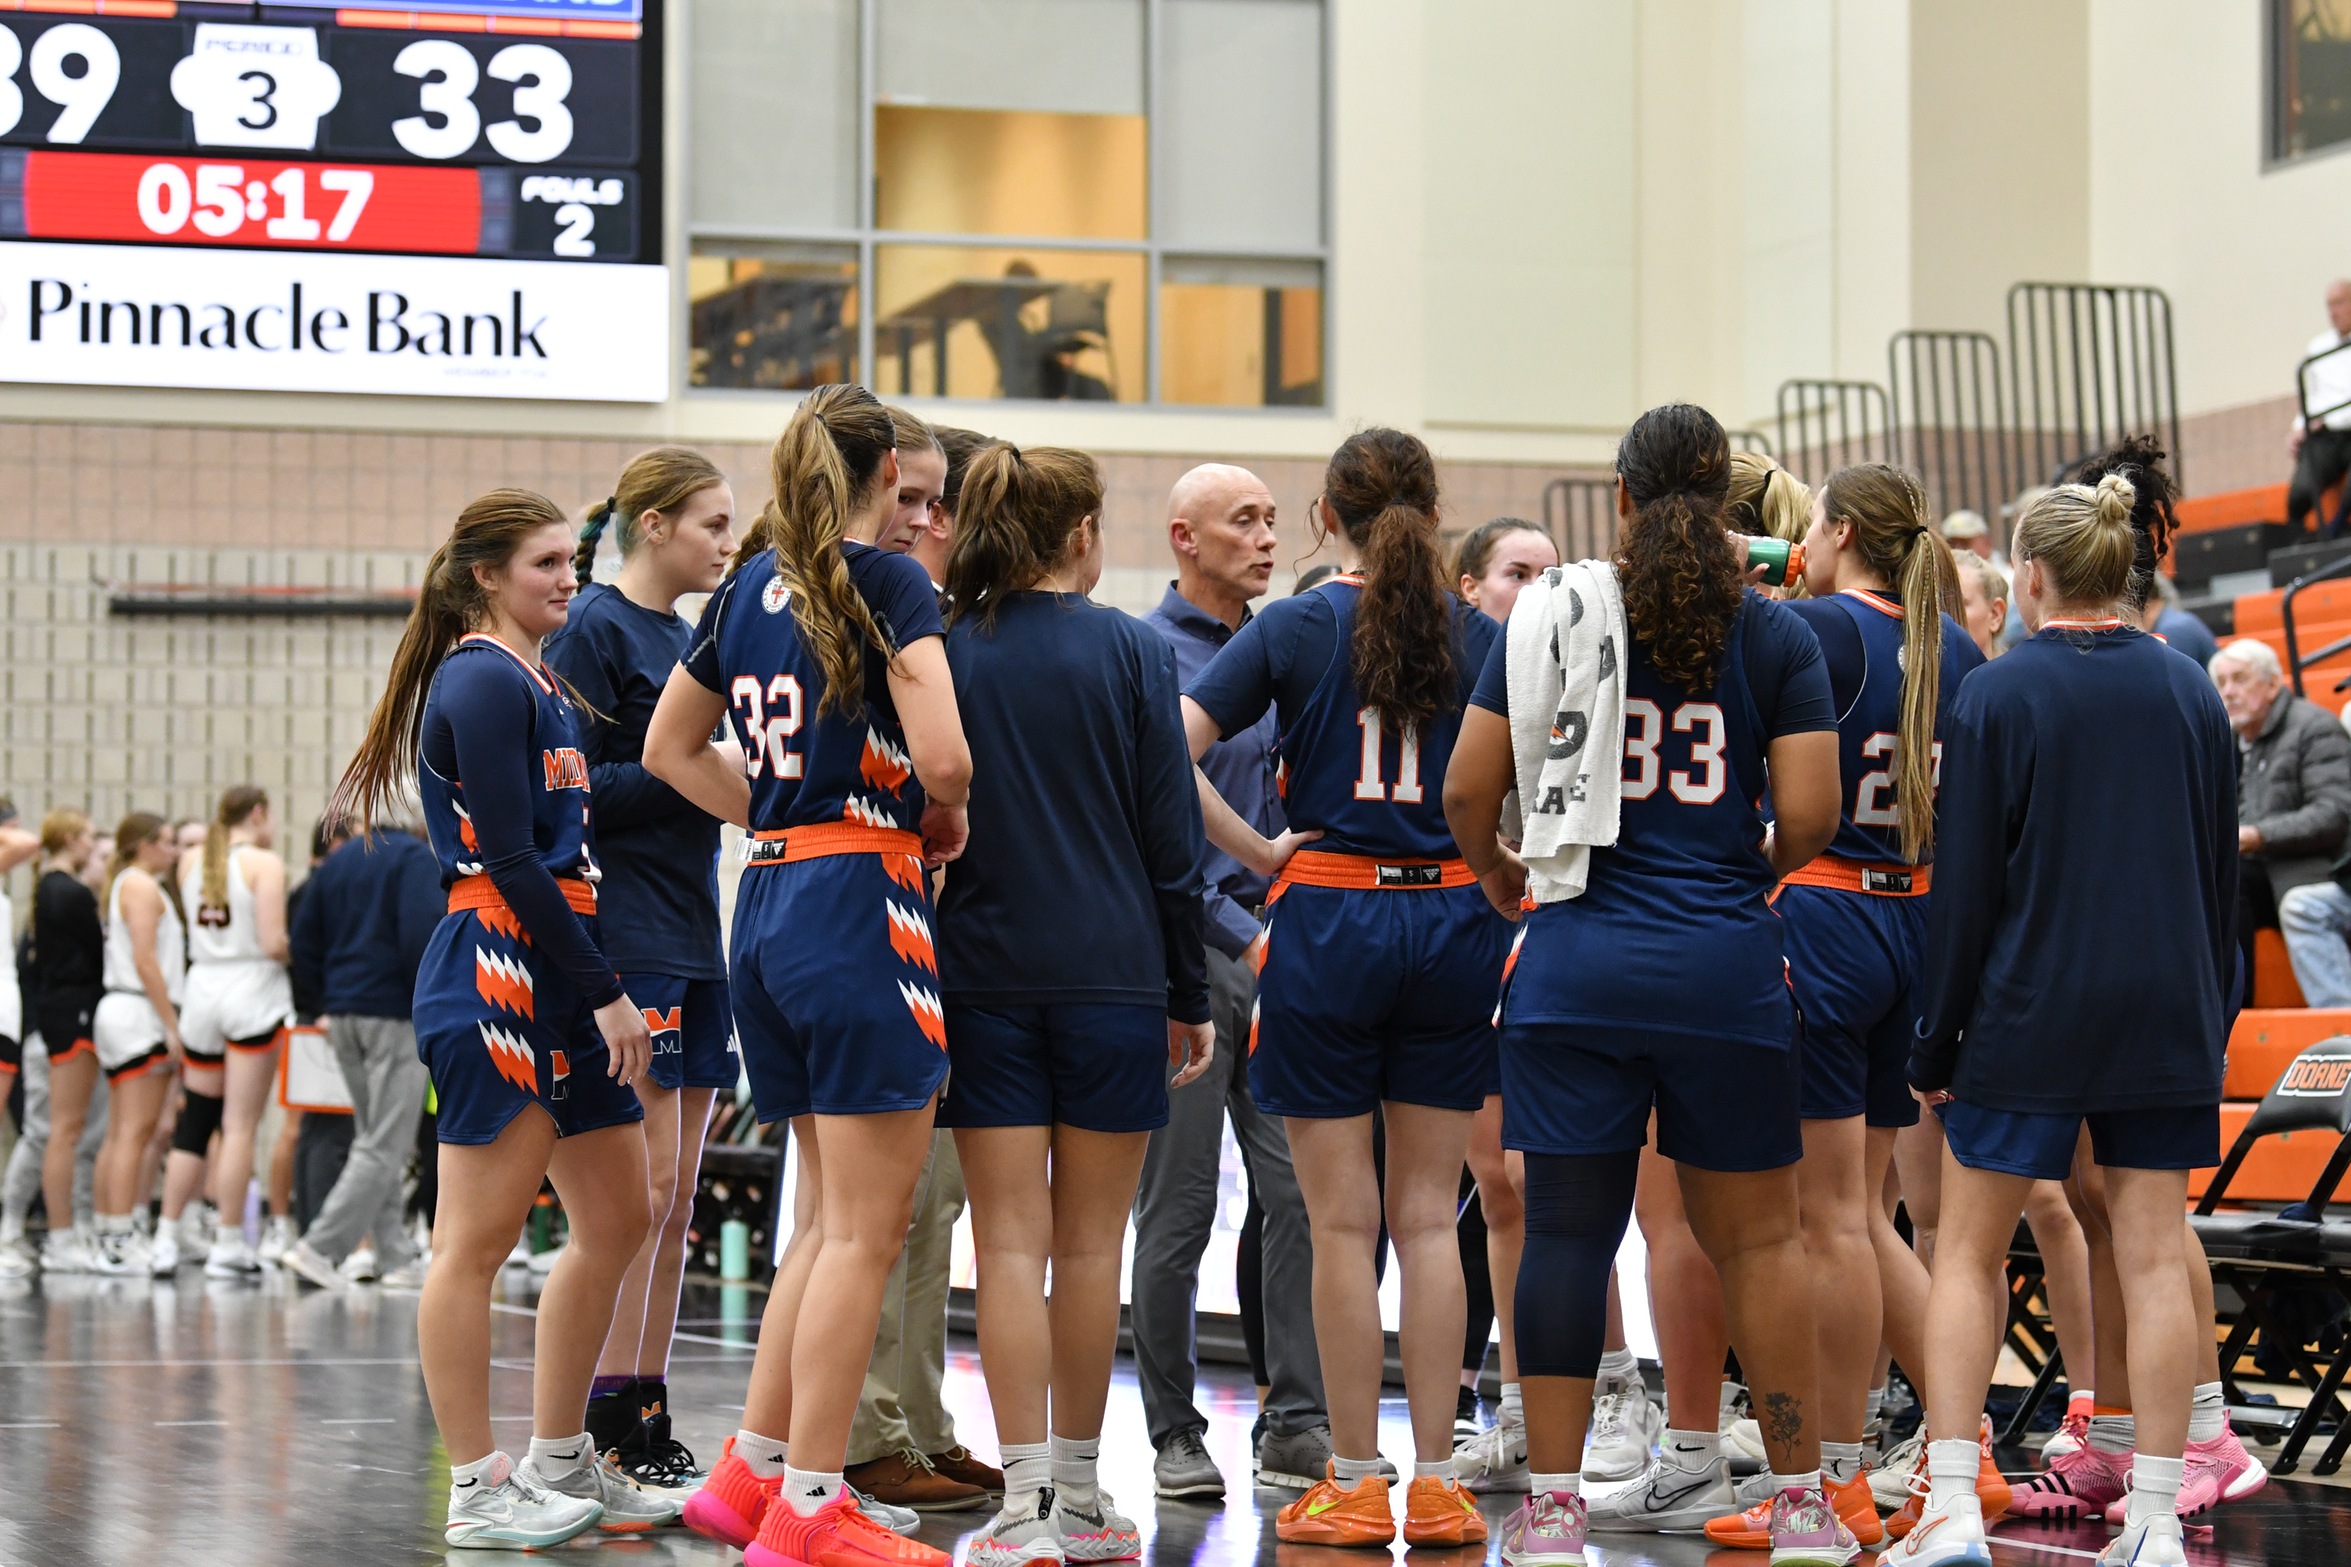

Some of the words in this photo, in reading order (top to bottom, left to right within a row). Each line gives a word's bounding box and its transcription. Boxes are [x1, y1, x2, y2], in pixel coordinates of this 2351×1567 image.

[0, 23, 121, 144] 9
[237, 70, 278, 130] 3
[392, 39, 574, 163] 33
[137, 163, 374, 241] 05:17
[520, 176, 624, 205] FOULS
[553, 205, 596, 257] 2
[29, 279, 349, 352] Pinnacle
[367, 290, 548, 359] Bank
[730, 674, 803, 780] 32
[1354, 704, 1423, 804] 11
[1620, 697, 1727, 806] 33
[2284, 1061, 2351, 1090] DOANE
